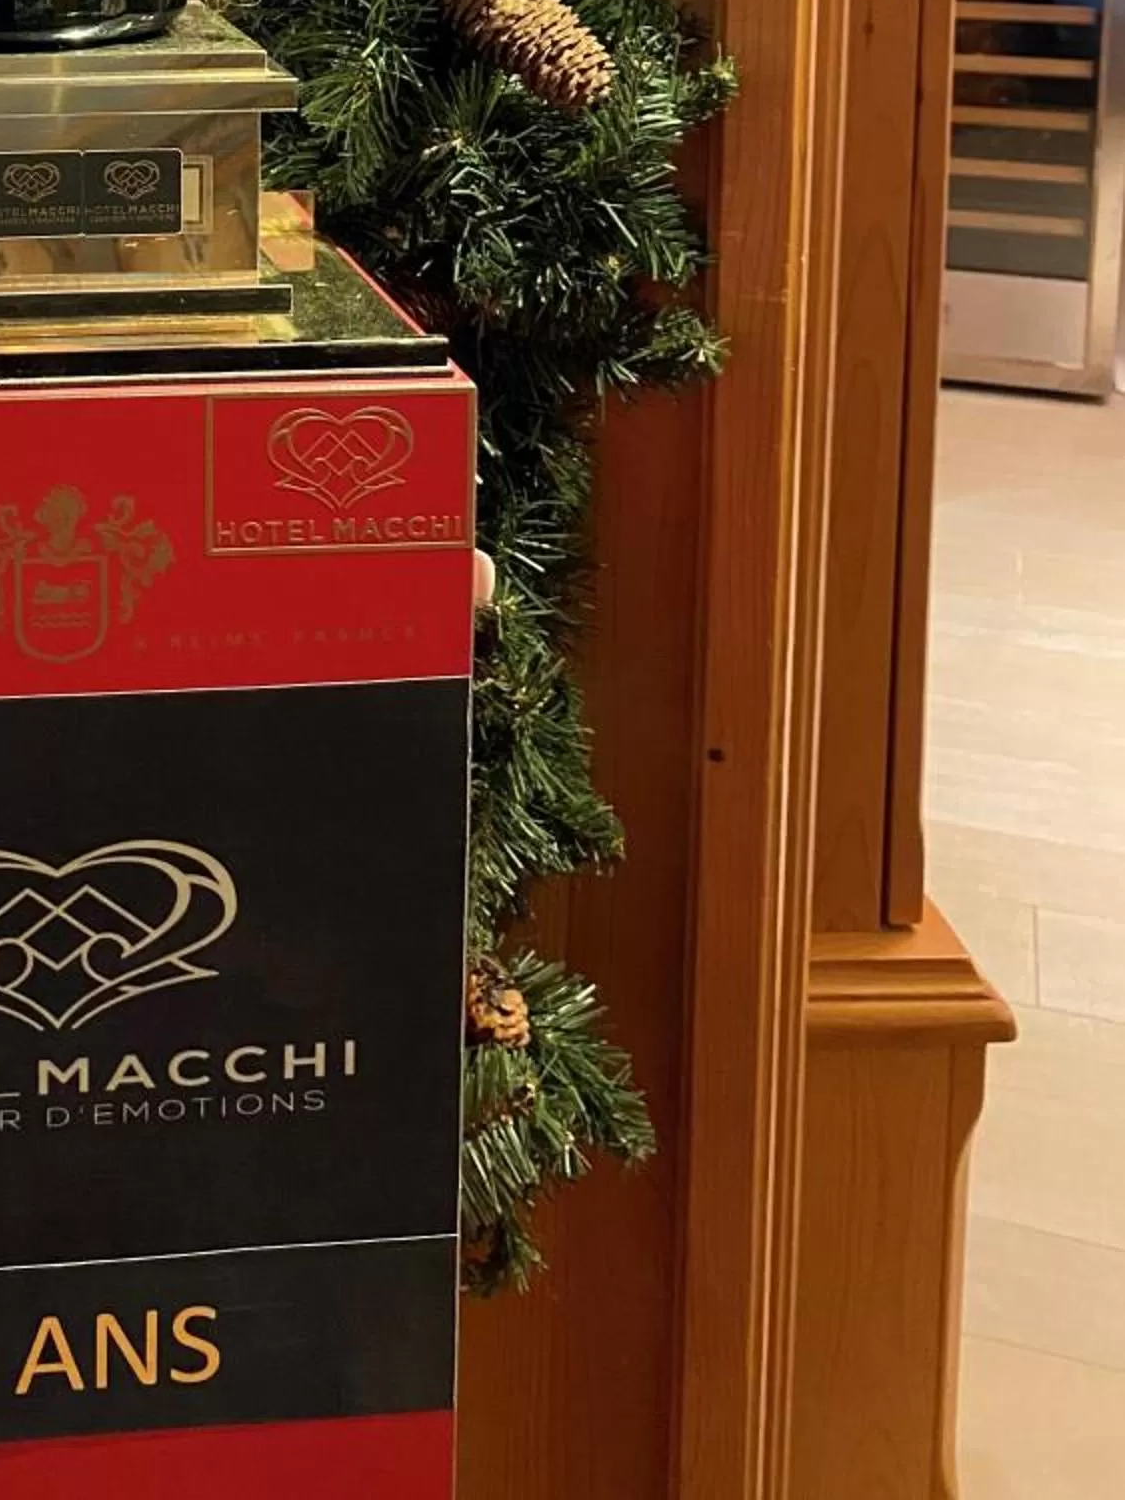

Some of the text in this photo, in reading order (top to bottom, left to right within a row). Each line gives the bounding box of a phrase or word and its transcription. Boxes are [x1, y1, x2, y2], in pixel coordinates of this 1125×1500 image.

[216, 514, 464, 545] HOTEL MACCHI
[45, 1088, 327, 1130] D'EMOTIONS
[14, 1305, 222, 1396] ANS
